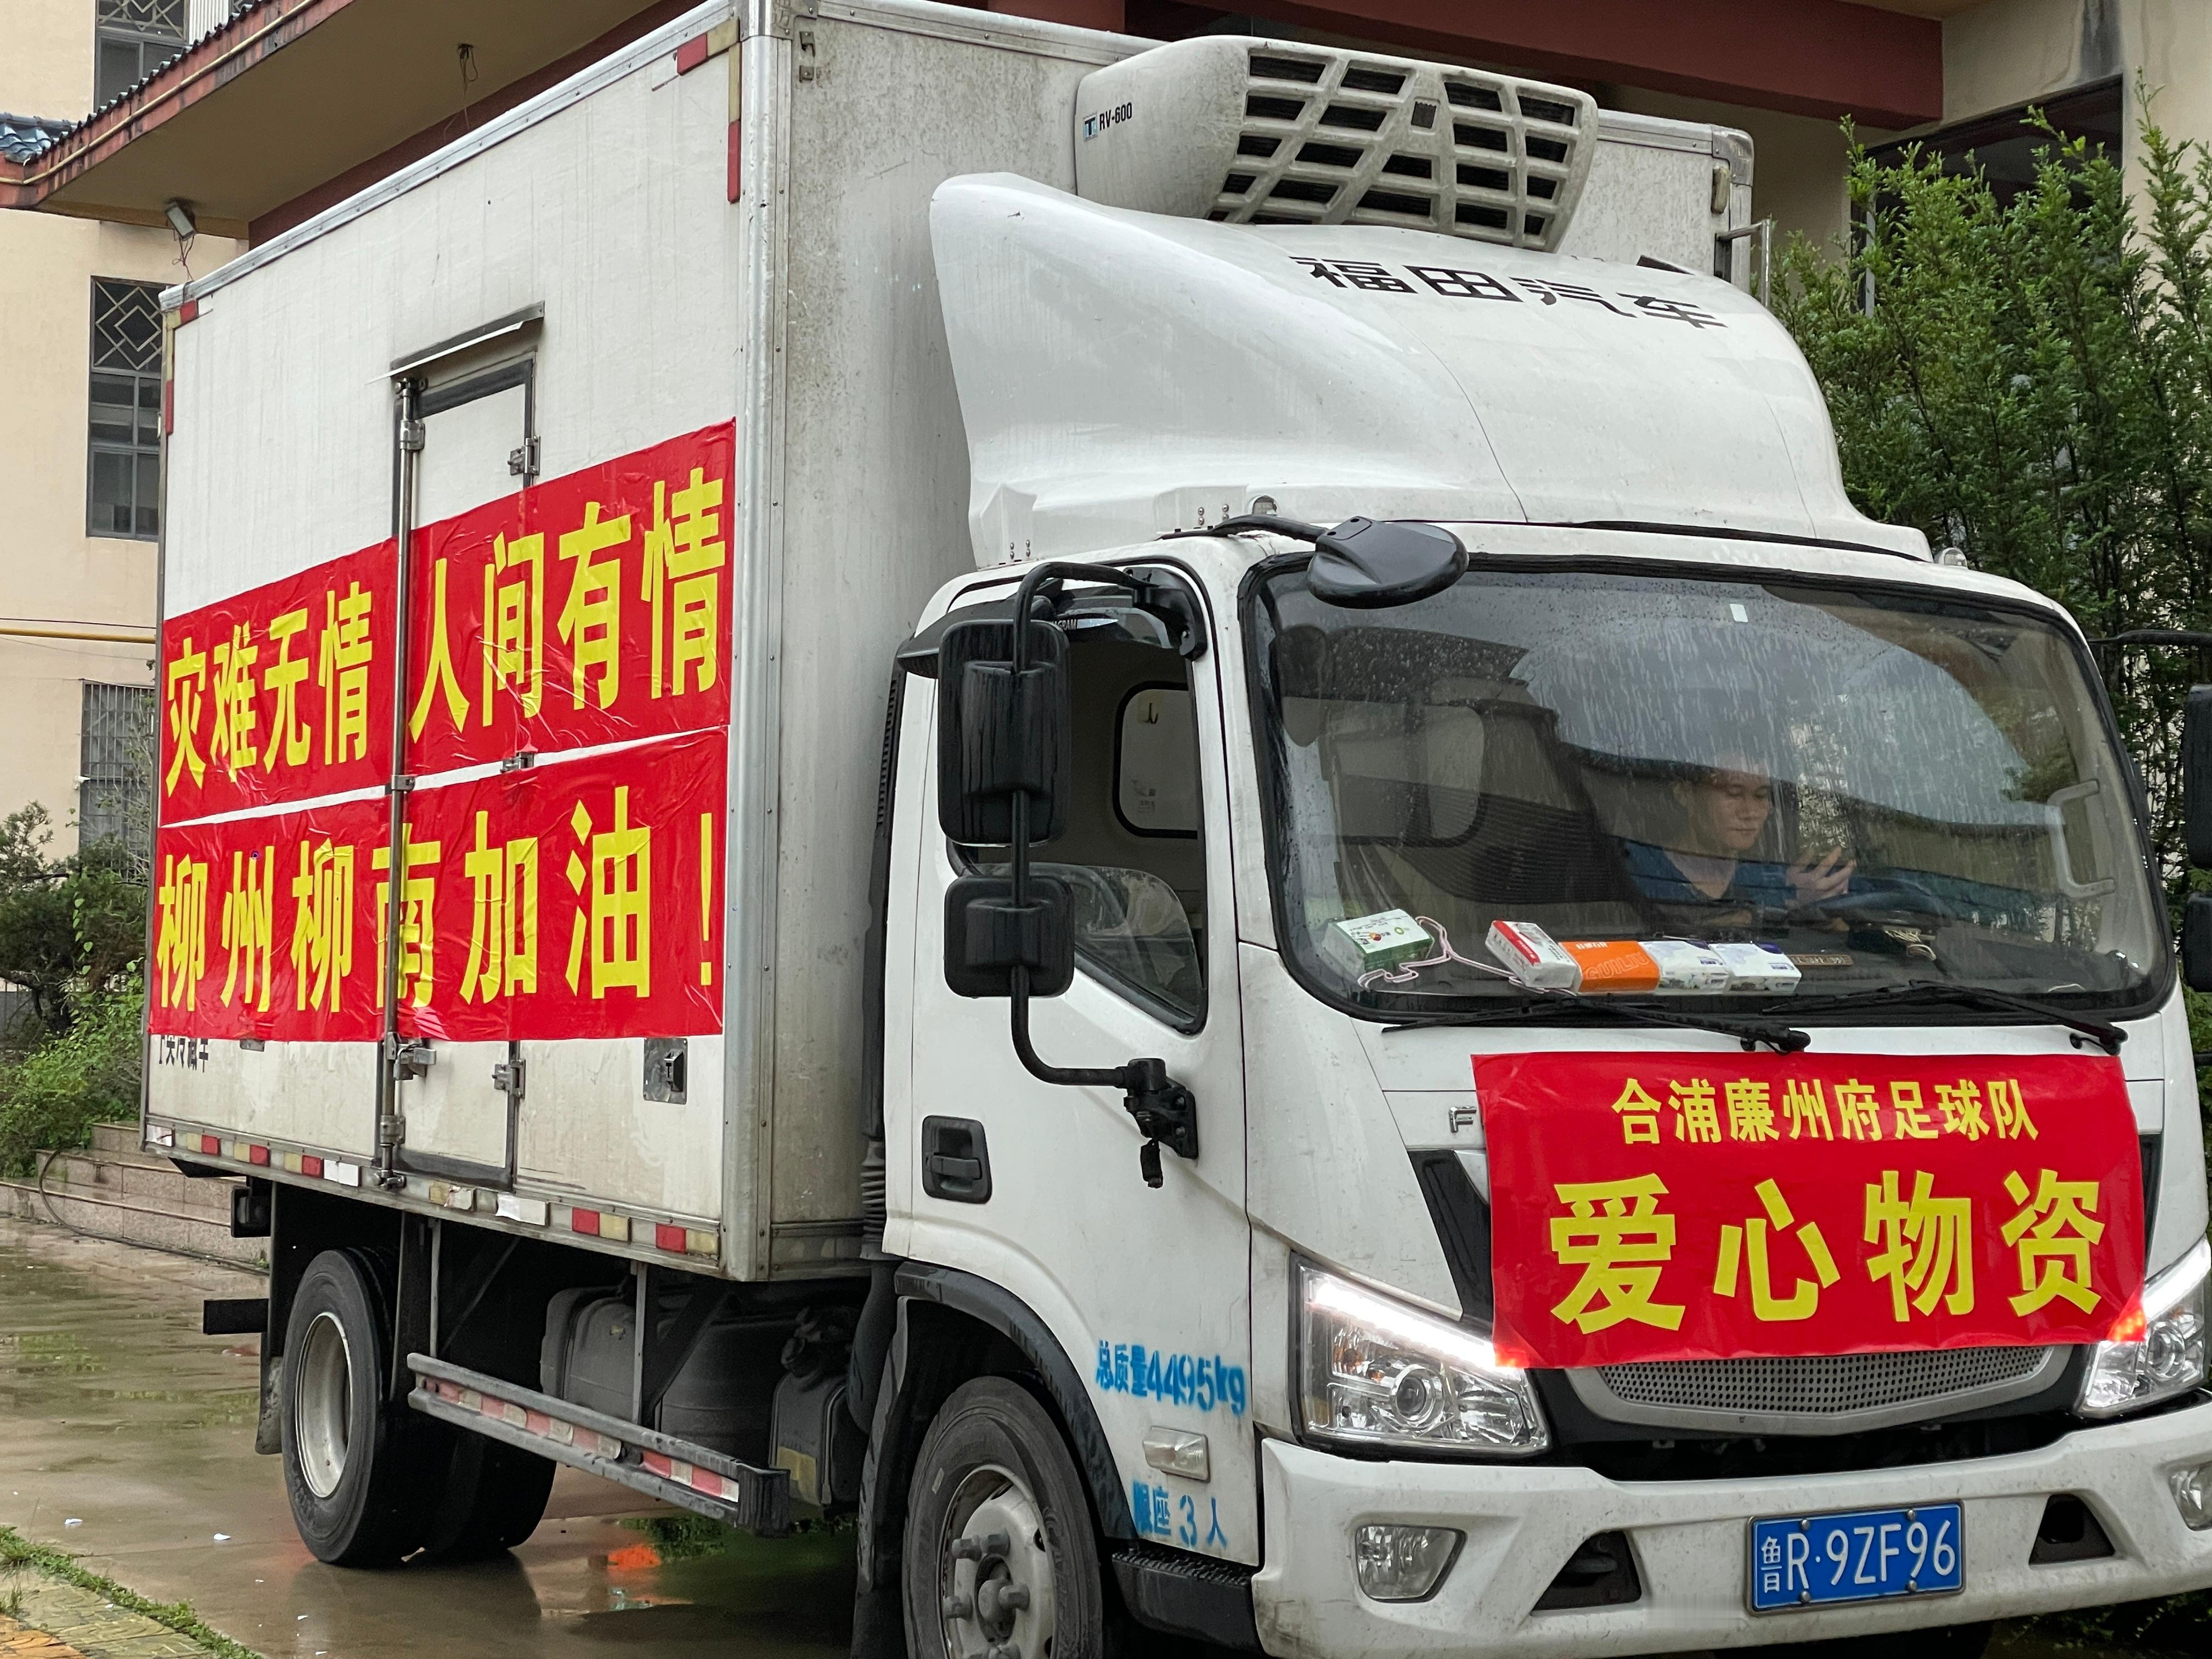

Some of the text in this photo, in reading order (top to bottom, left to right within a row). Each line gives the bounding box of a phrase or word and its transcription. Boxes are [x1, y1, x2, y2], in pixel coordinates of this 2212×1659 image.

[1099, 102, 1132, 131] RV-600
[1289, 256, 1727, 329] 福田汽车
[166, 467, 726, 797] 灾难无情 人间有情
[1611, 1077, 2039, 1144] 合浦廉州府足球队
[1550, 1169, 2106, 1334] 爱心物资
